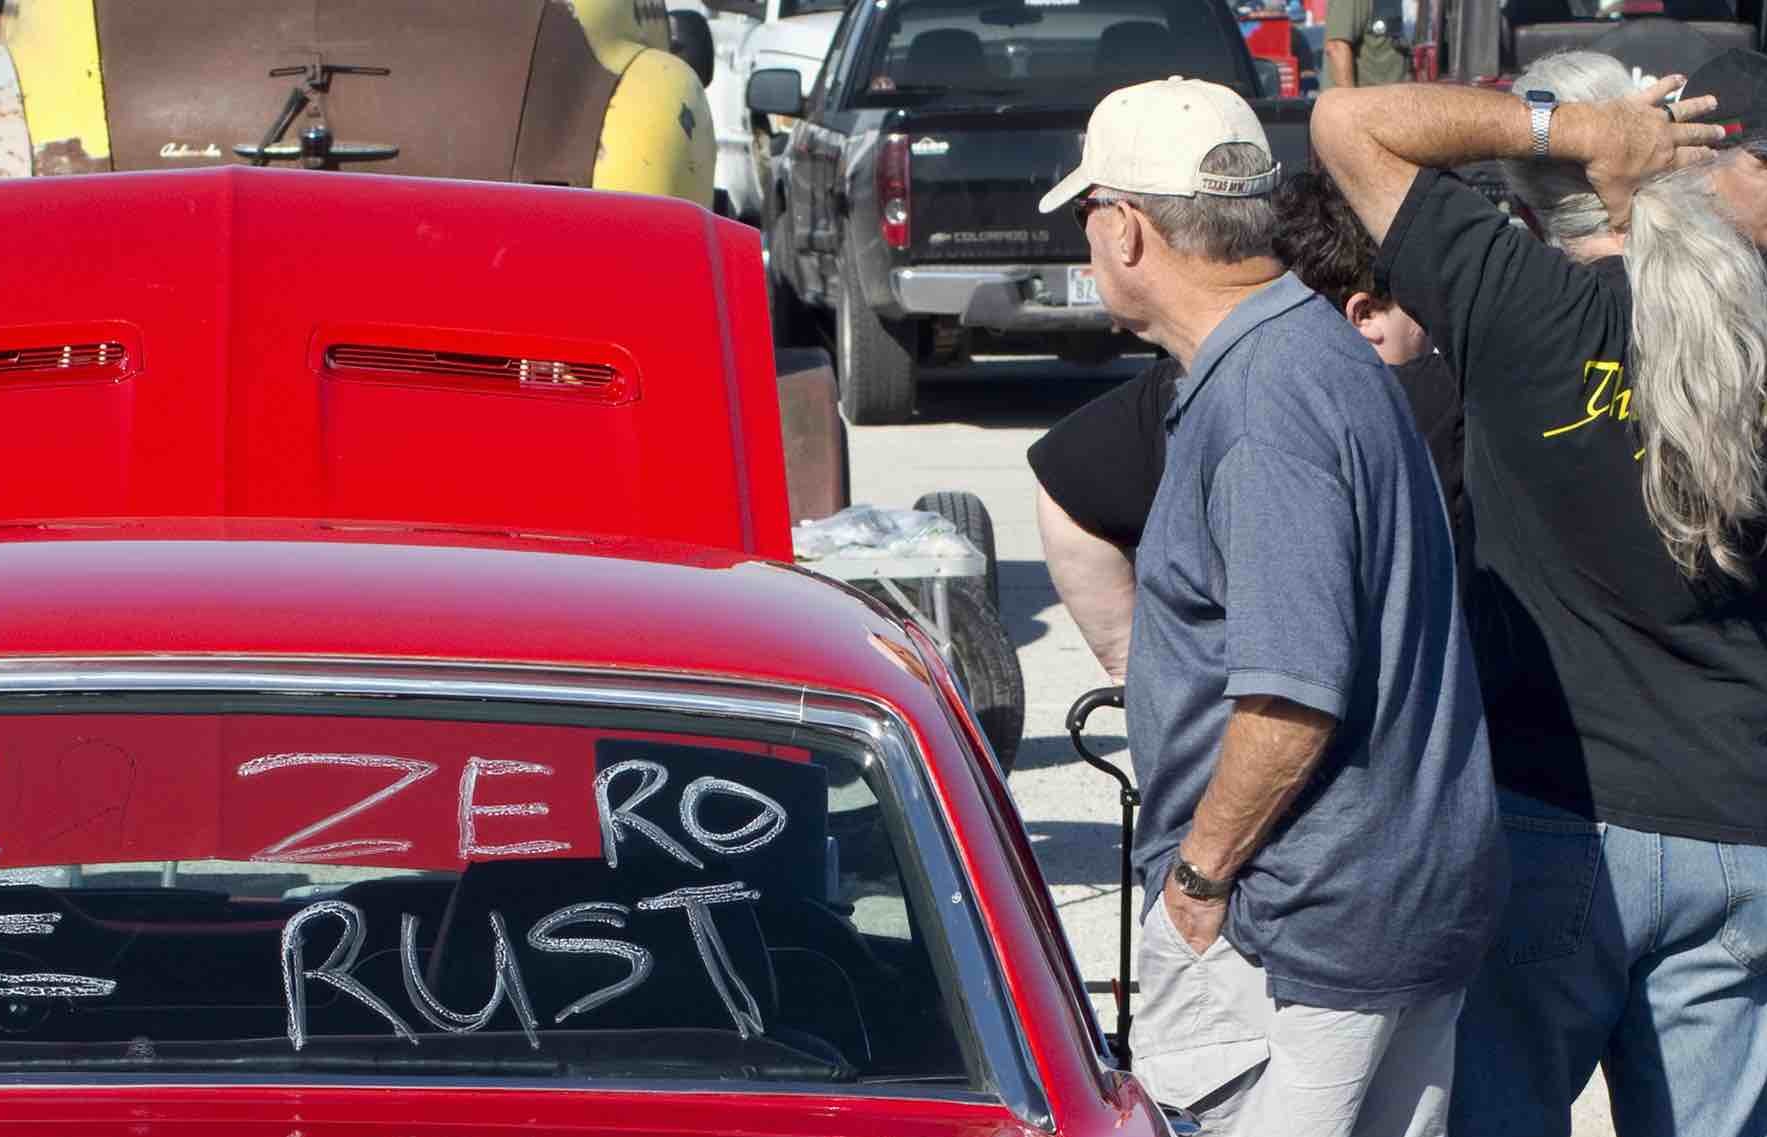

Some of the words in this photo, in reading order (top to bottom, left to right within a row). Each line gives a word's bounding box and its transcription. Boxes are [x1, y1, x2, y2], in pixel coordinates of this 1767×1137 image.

[1201, 178, 1229, 193] TEXAS
[237, 751, 788, 870] ZERO
[281, 881, 765, 1050] RUST
